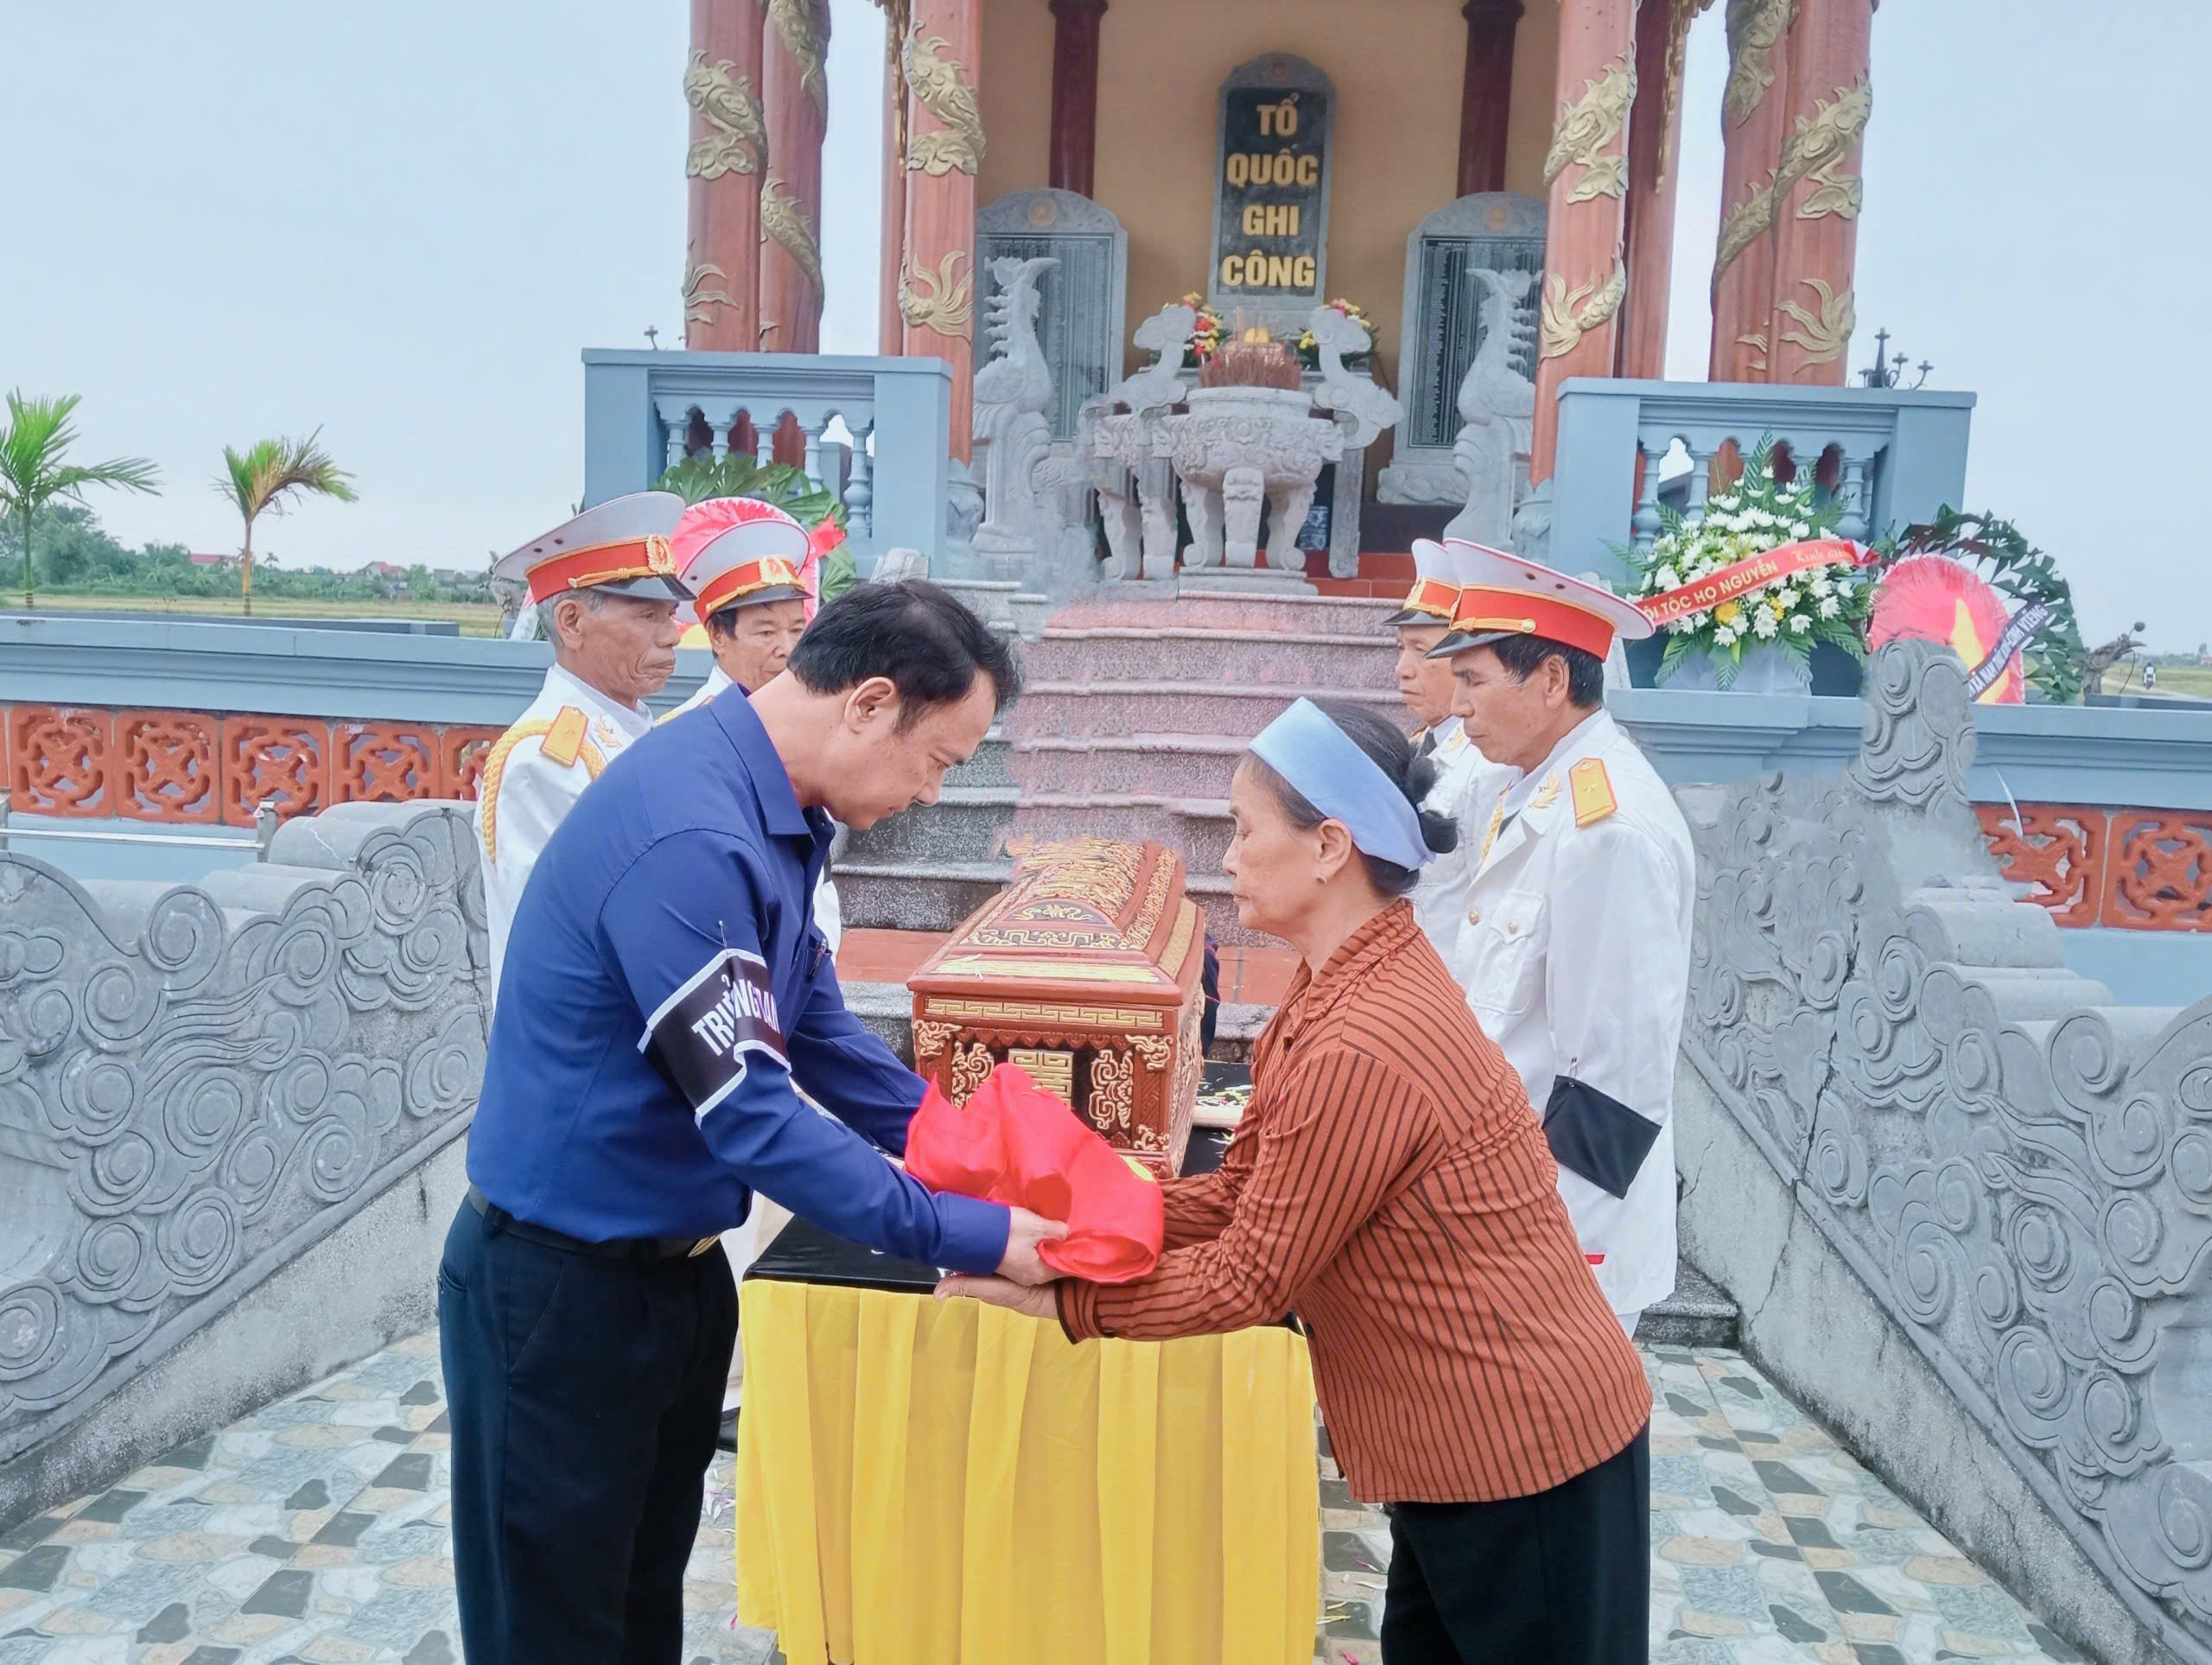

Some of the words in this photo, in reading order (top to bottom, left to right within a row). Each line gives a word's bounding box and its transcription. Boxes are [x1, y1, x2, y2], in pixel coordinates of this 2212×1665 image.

[1256, 92, 1300, 137] TỔ
[1226, 144, 1319, 187] QUỐC
[1243, 205, 1300, 236] GHI
[1222, 249, 1315, 288] CÔNG
[1661, 595, 1692, 616] TỘC
[1694, 586, 1717, 602] HỌ
[1719, 559, 1778, 595] NGUYỄN
